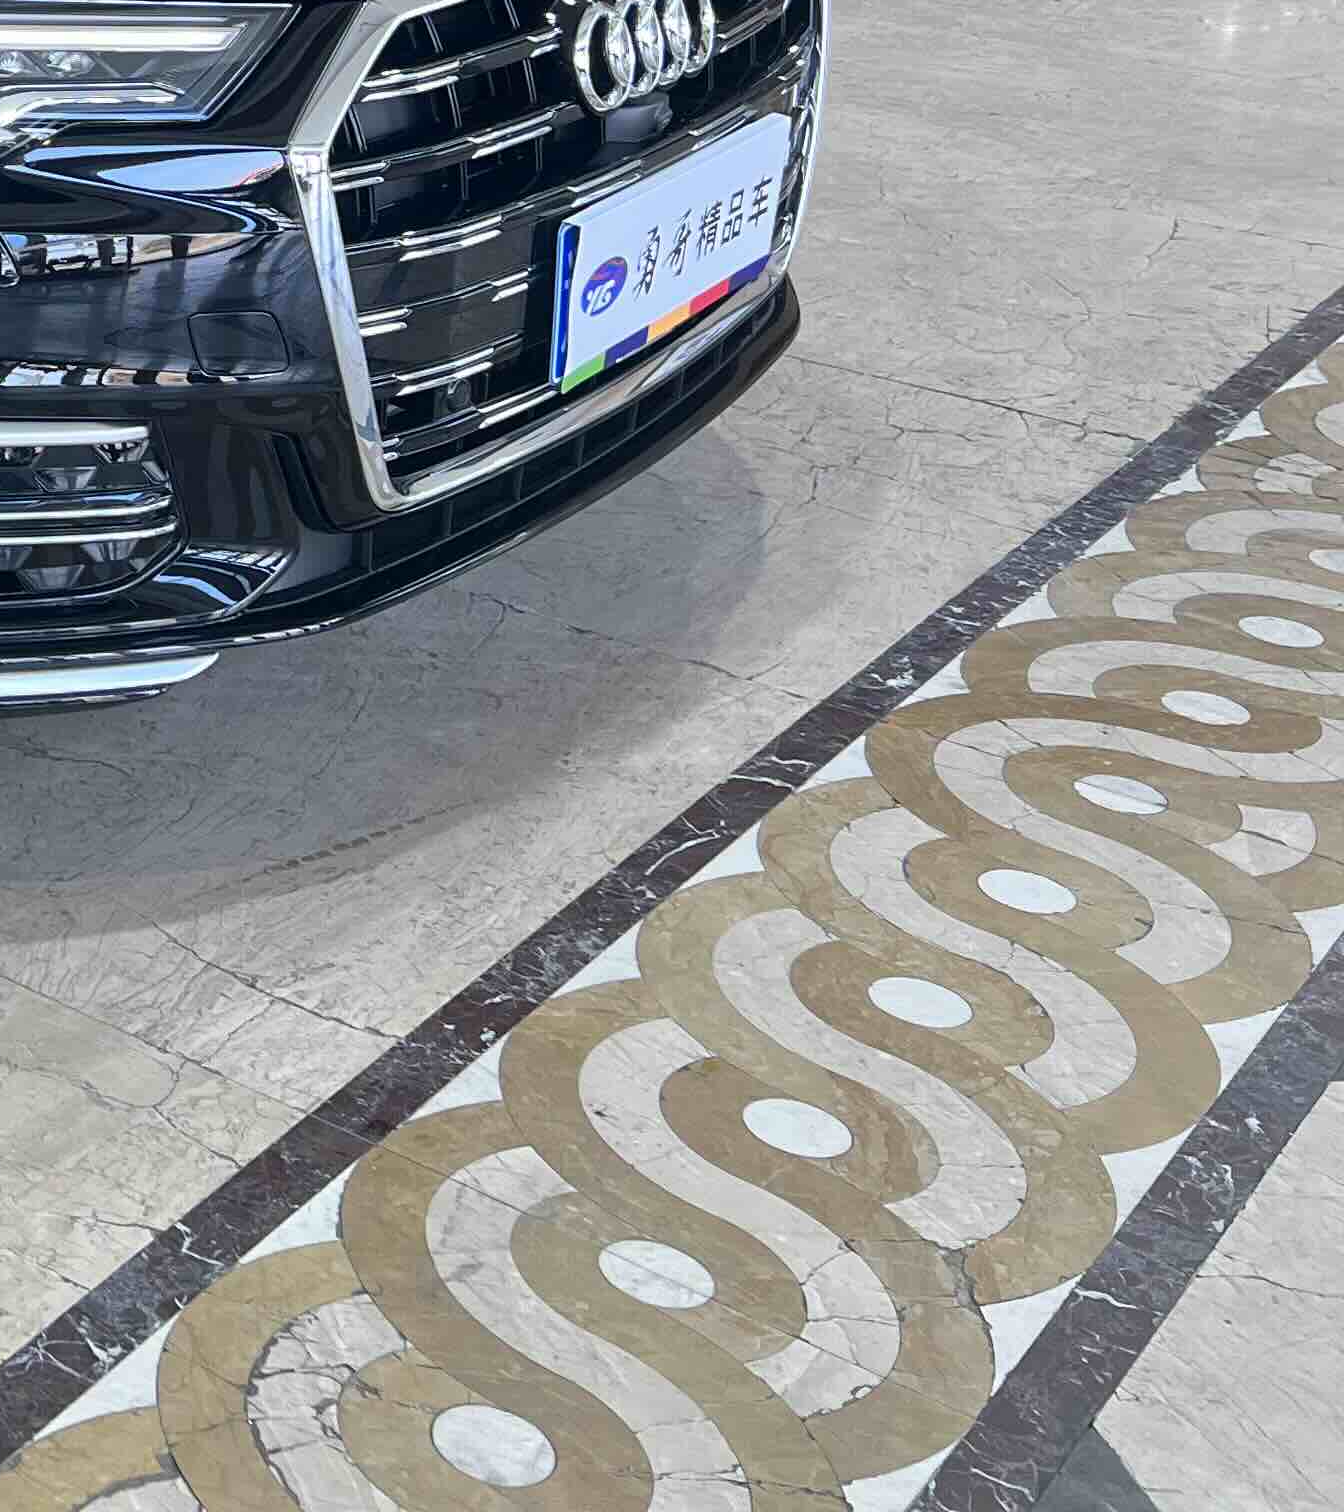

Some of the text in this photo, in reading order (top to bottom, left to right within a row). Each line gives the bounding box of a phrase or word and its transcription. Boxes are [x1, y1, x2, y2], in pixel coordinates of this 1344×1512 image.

[633, 174, 774, 300] 勇哥精品车
